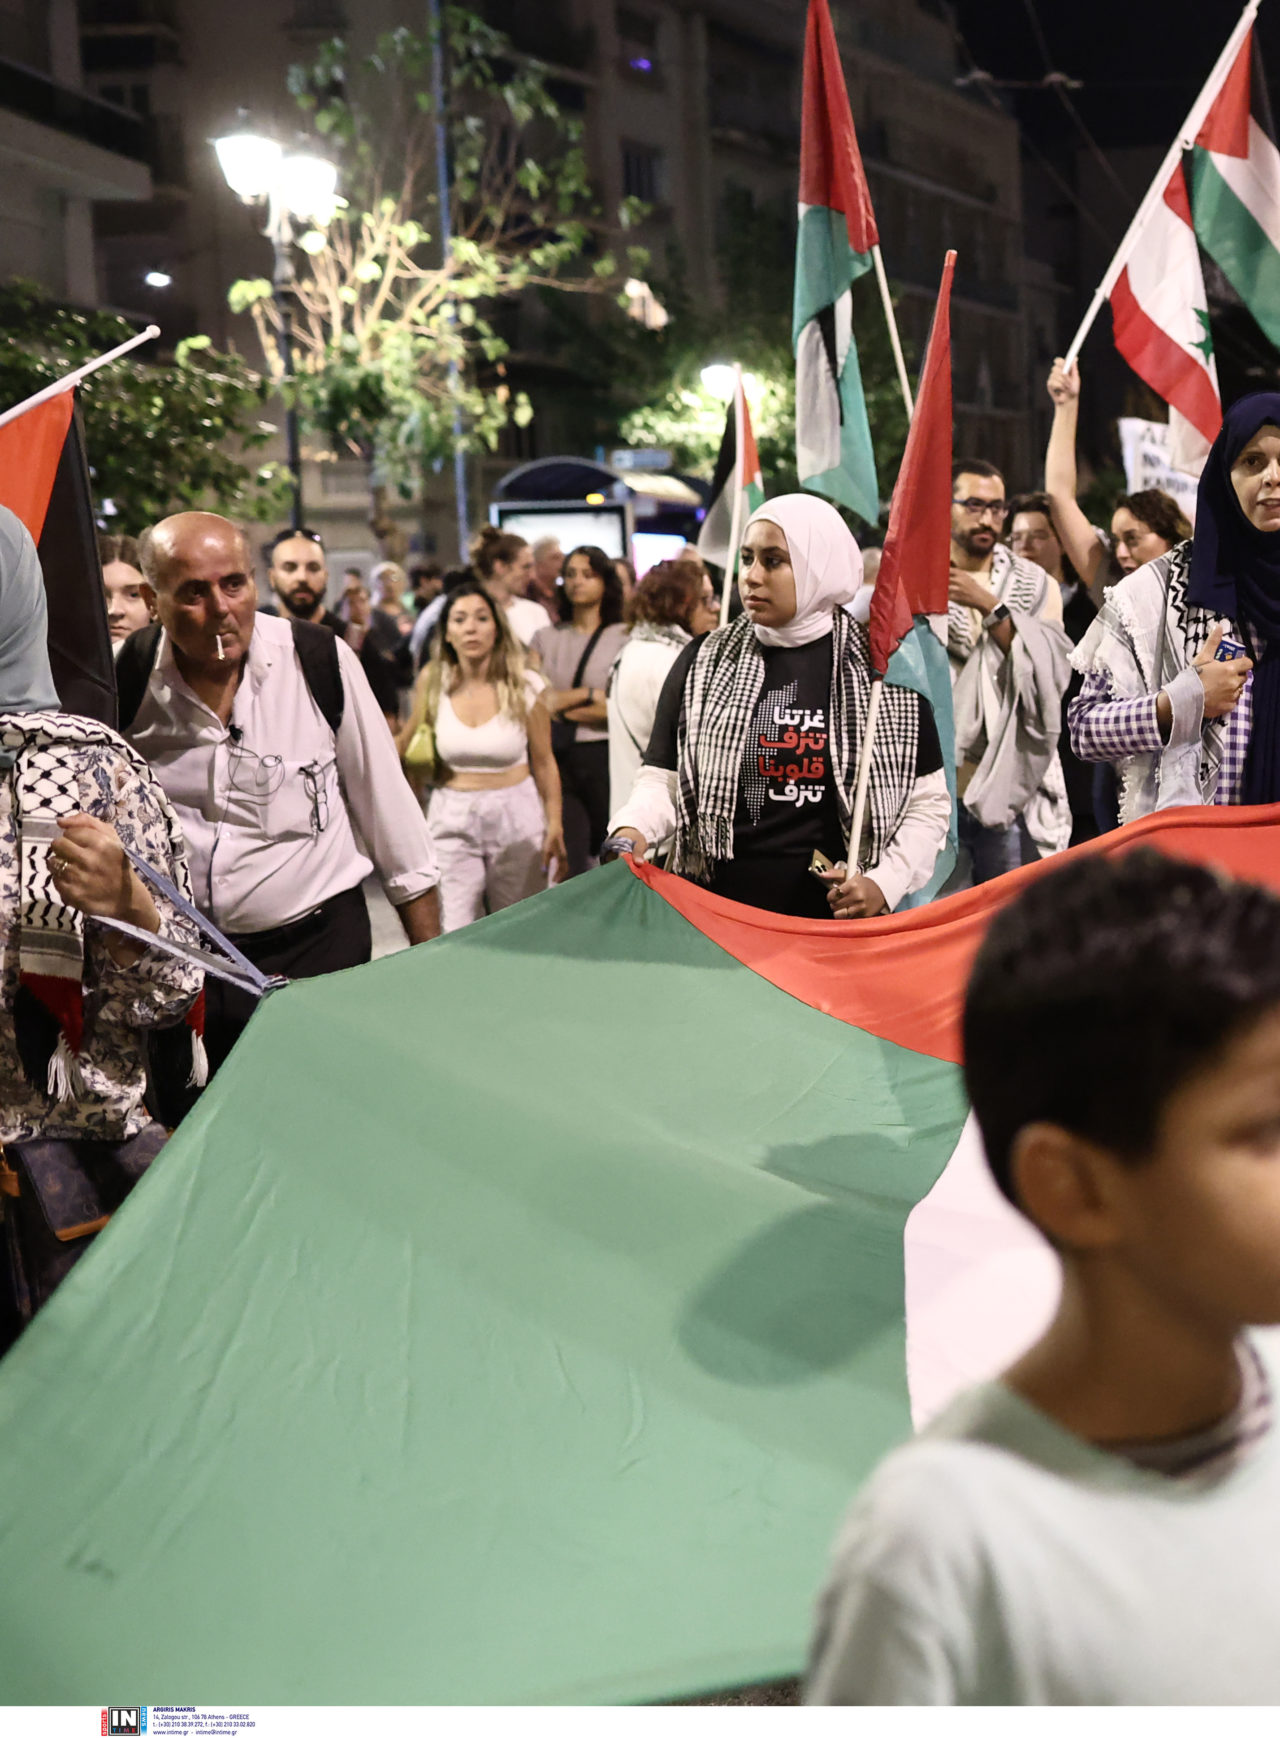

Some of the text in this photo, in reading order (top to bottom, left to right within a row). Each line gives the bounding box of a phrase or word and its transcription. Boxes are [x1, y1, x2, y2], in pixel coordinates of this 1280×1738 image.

[773, 706, 825, 732] غزتنا
[760, 726, 828, 755] تنزف
[759, 756, 824, 782] قلوبنا
[768, 780, 825, 808] تنزف
